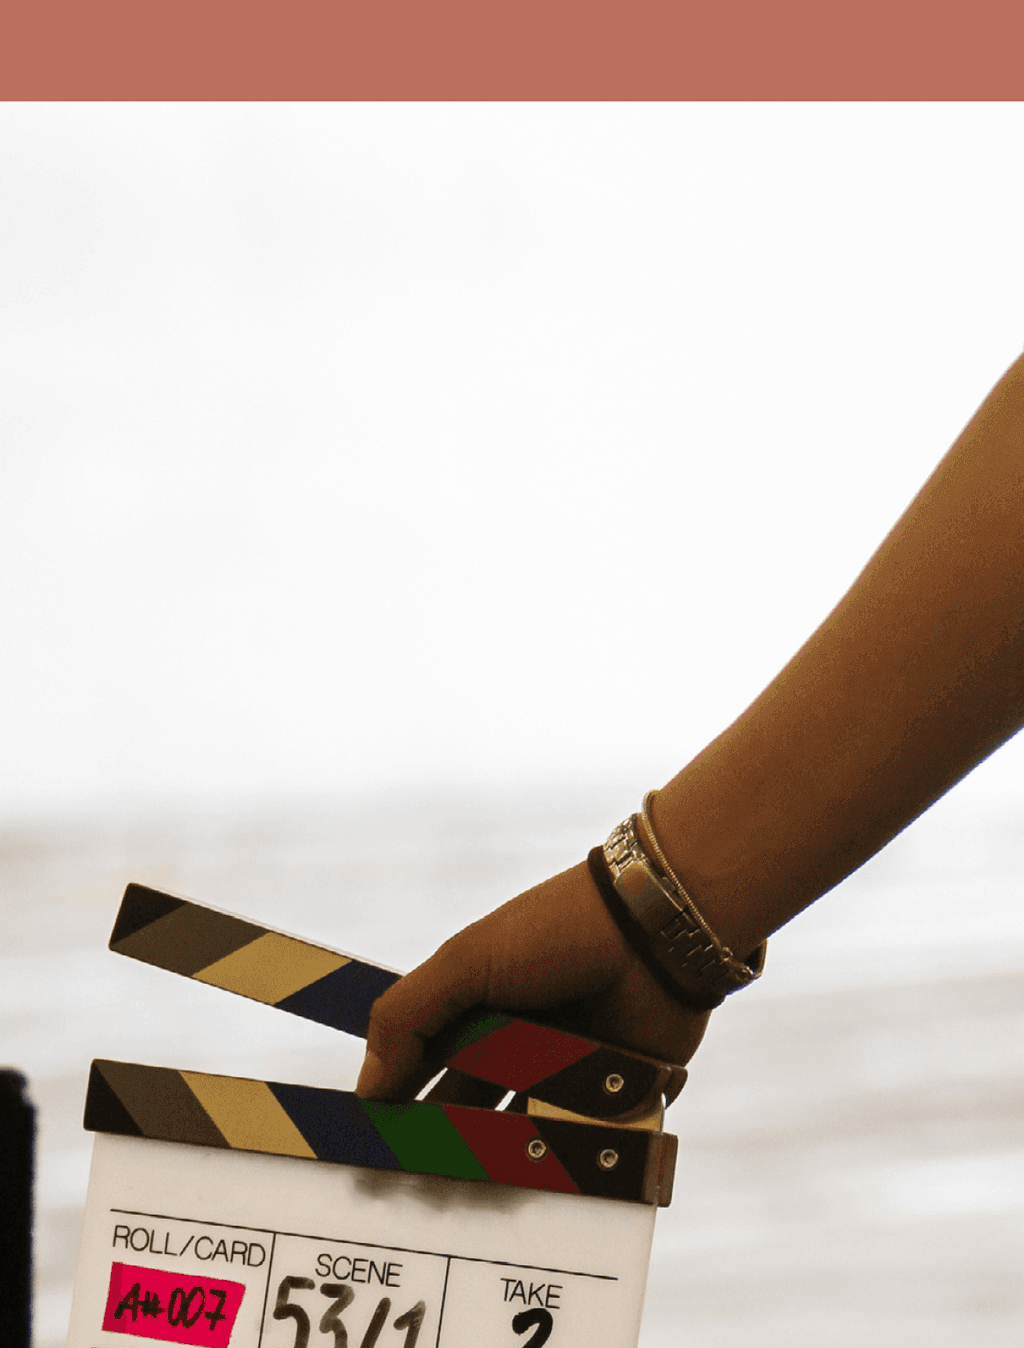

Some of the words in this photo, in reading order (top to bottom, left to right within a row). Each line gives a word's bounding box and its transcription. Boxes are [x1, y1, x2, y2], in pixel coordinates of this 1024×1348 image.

[112, 1224, 267, 1268] ROLL/CARD
[315, 1253, 403, 1288] SCENE
[500, 1278, 563, 1309] TAKE
